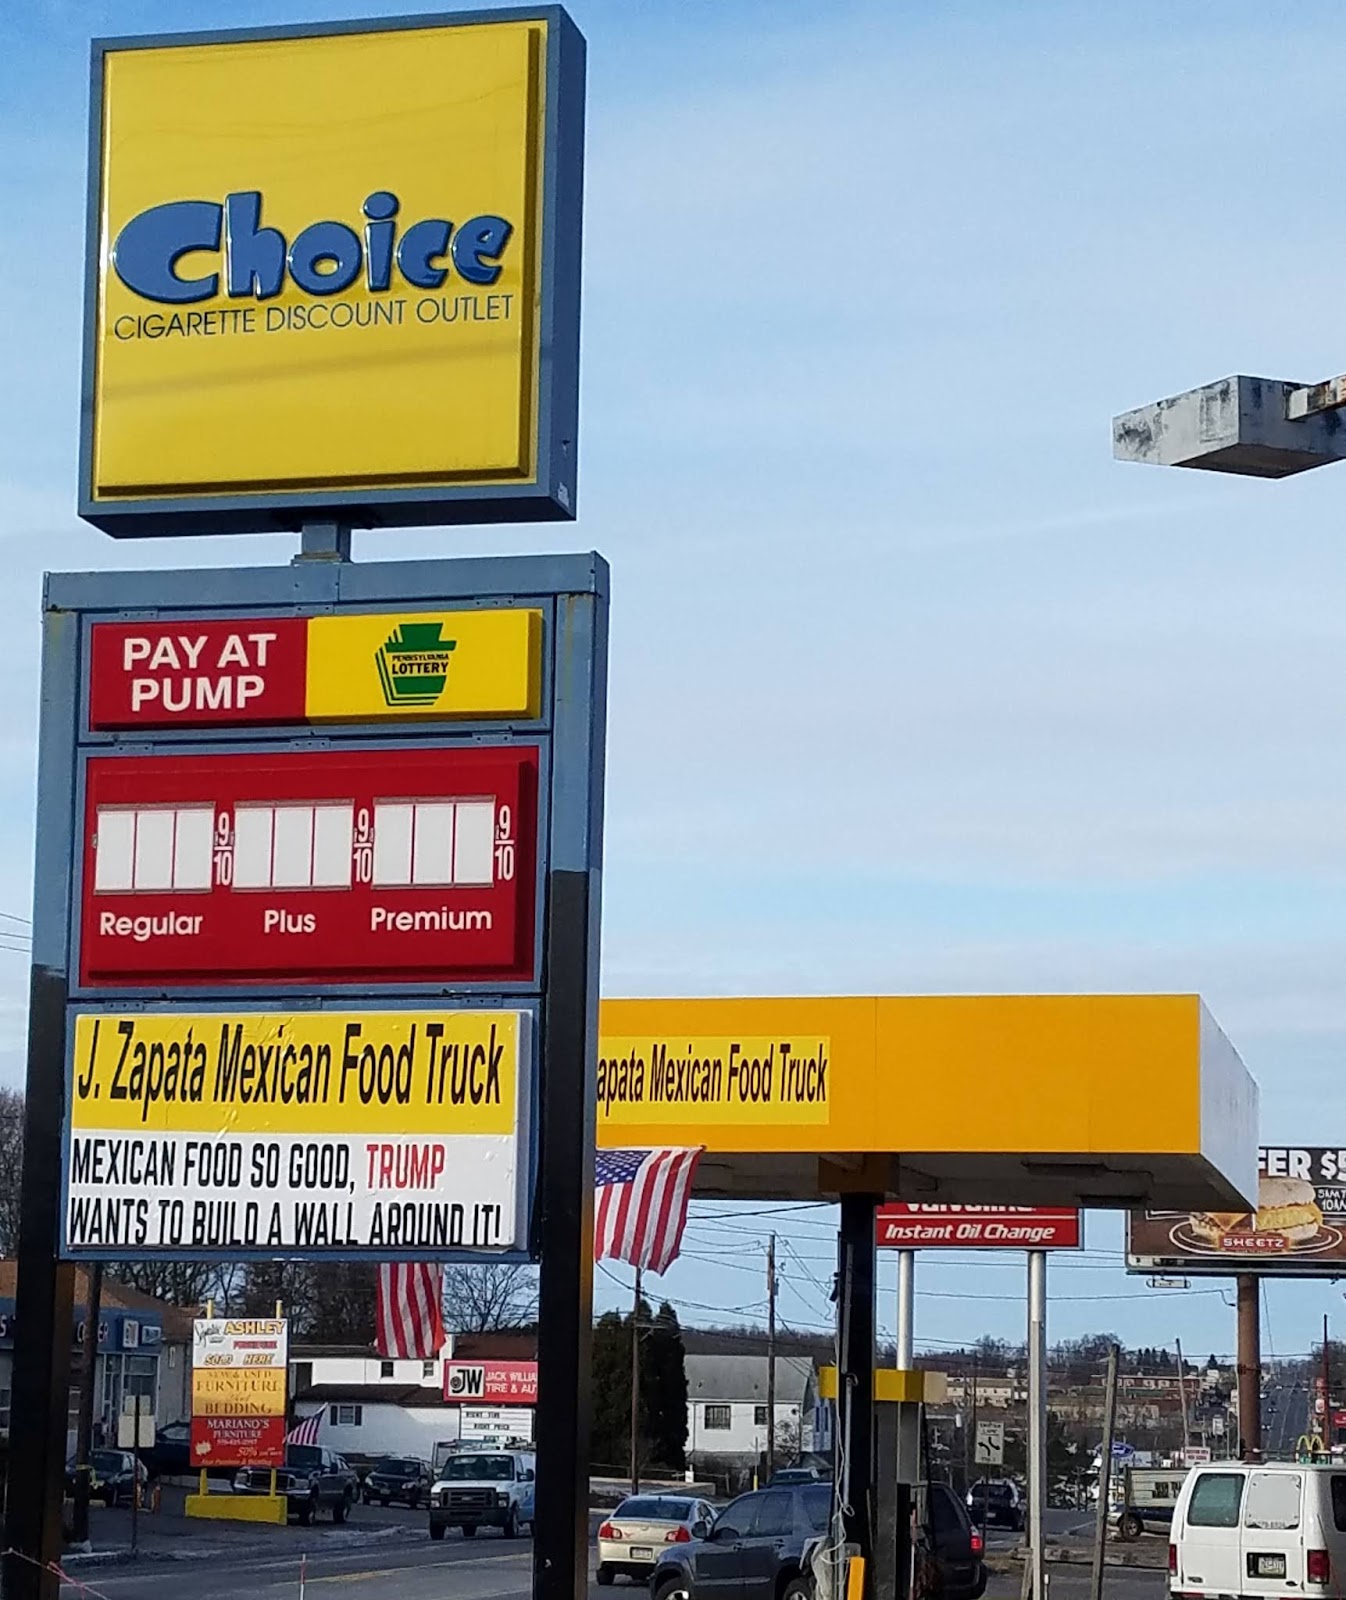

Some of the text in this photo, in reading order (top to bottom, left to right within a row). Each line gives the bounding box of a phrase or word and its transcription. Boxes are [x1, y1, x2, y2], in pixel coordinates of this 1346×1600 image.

[111, 190, 514, 304] Choice
[115, 295, 513, 340] CIGARETTE DISCOUNT OUTLET
[123, 634, 277, 671] PAY AT
[392, 662, 449, 674] LOTTERY
[130, 676, 266, 712] PUMP
[99, 906, 492, 942] Regular Plus Premium
[77, 1020, 505, 1121] J. Zapata Mexican Food Truck
[597, 1043, 828, 1117] apata Mexican Food Truck
[72, 1138, 445, 1194] MEXICAN FOOD SO GOOD, TRUMP
[70, 1197, 502, 1246] WANTS TO BUILD A WALL AROUND IT!
[885, 1224, 1056, 1243] Instant Oil Change
[1223, 1238, 1285, 1248] SHEETZ
[224, 1321, 286, 1335] ASHLEY
[196, 1380, 281, 1391] FURNITURE
[451, 1369, 482, 1394] JW
[485, 1371, 537, 1382] JACK WILLIA
[485, 1384, 508, 1393] TIRE
[205, 1402, 272, 1414] BEDDING
[207, 1419, 270, 1429] MARIANO'S
